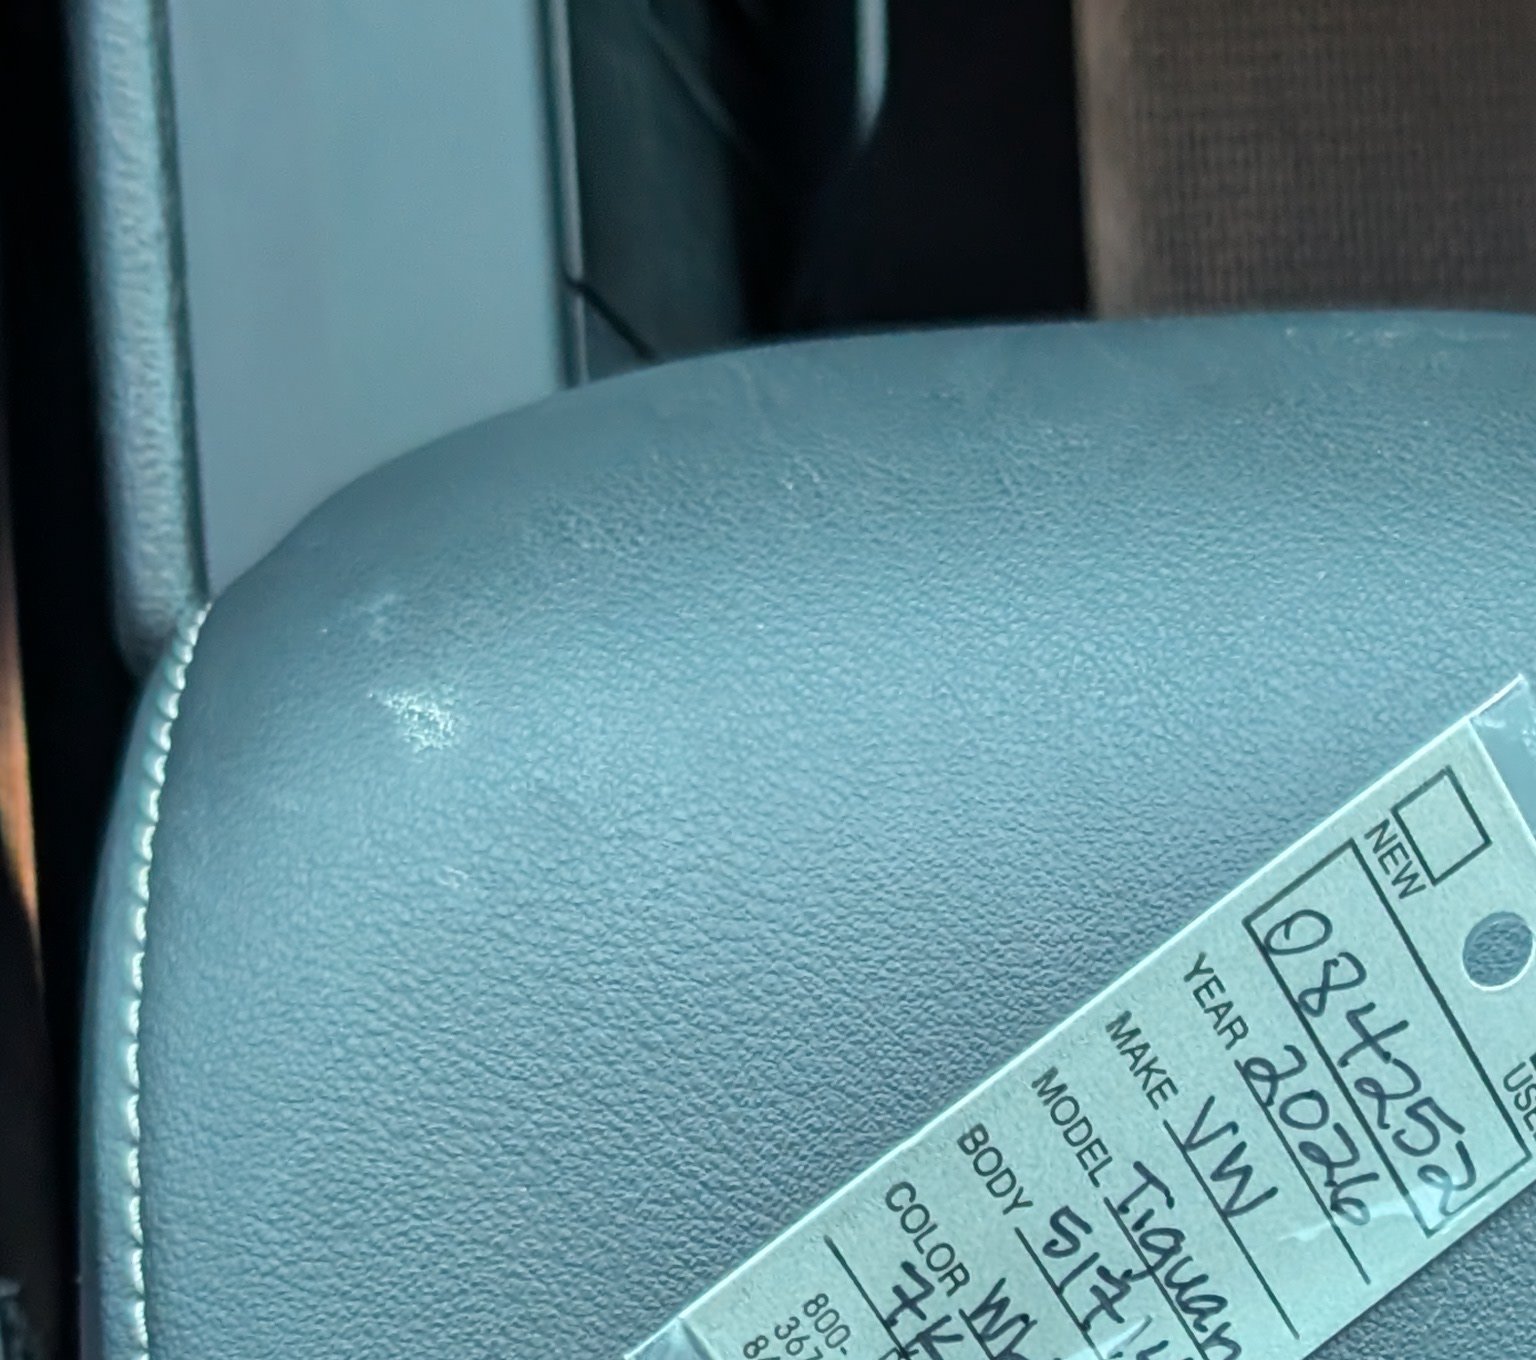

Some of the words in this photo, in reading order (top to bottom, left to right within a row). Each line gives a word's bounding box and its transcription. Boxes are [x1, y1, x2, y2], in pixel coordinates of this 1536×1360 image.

[1364, 819, 1426, 900] NEW
[1105, 1010, 1179, 1110] MAKE
[1183, 1095, 1279, 1219] VW
[1183, 951, 1250, 1051] YEAR
[1242, 1044, 1381, 1227] 2026
[1264, 908, 1478, 1216] 084252
[956, 1123, 1034, 1216] BODY
[1031, 1066, 1113, 1188] MODEL
[884, 1181, 971, 1297] COLOR
[802, 1292, 852, 1356] 800-
